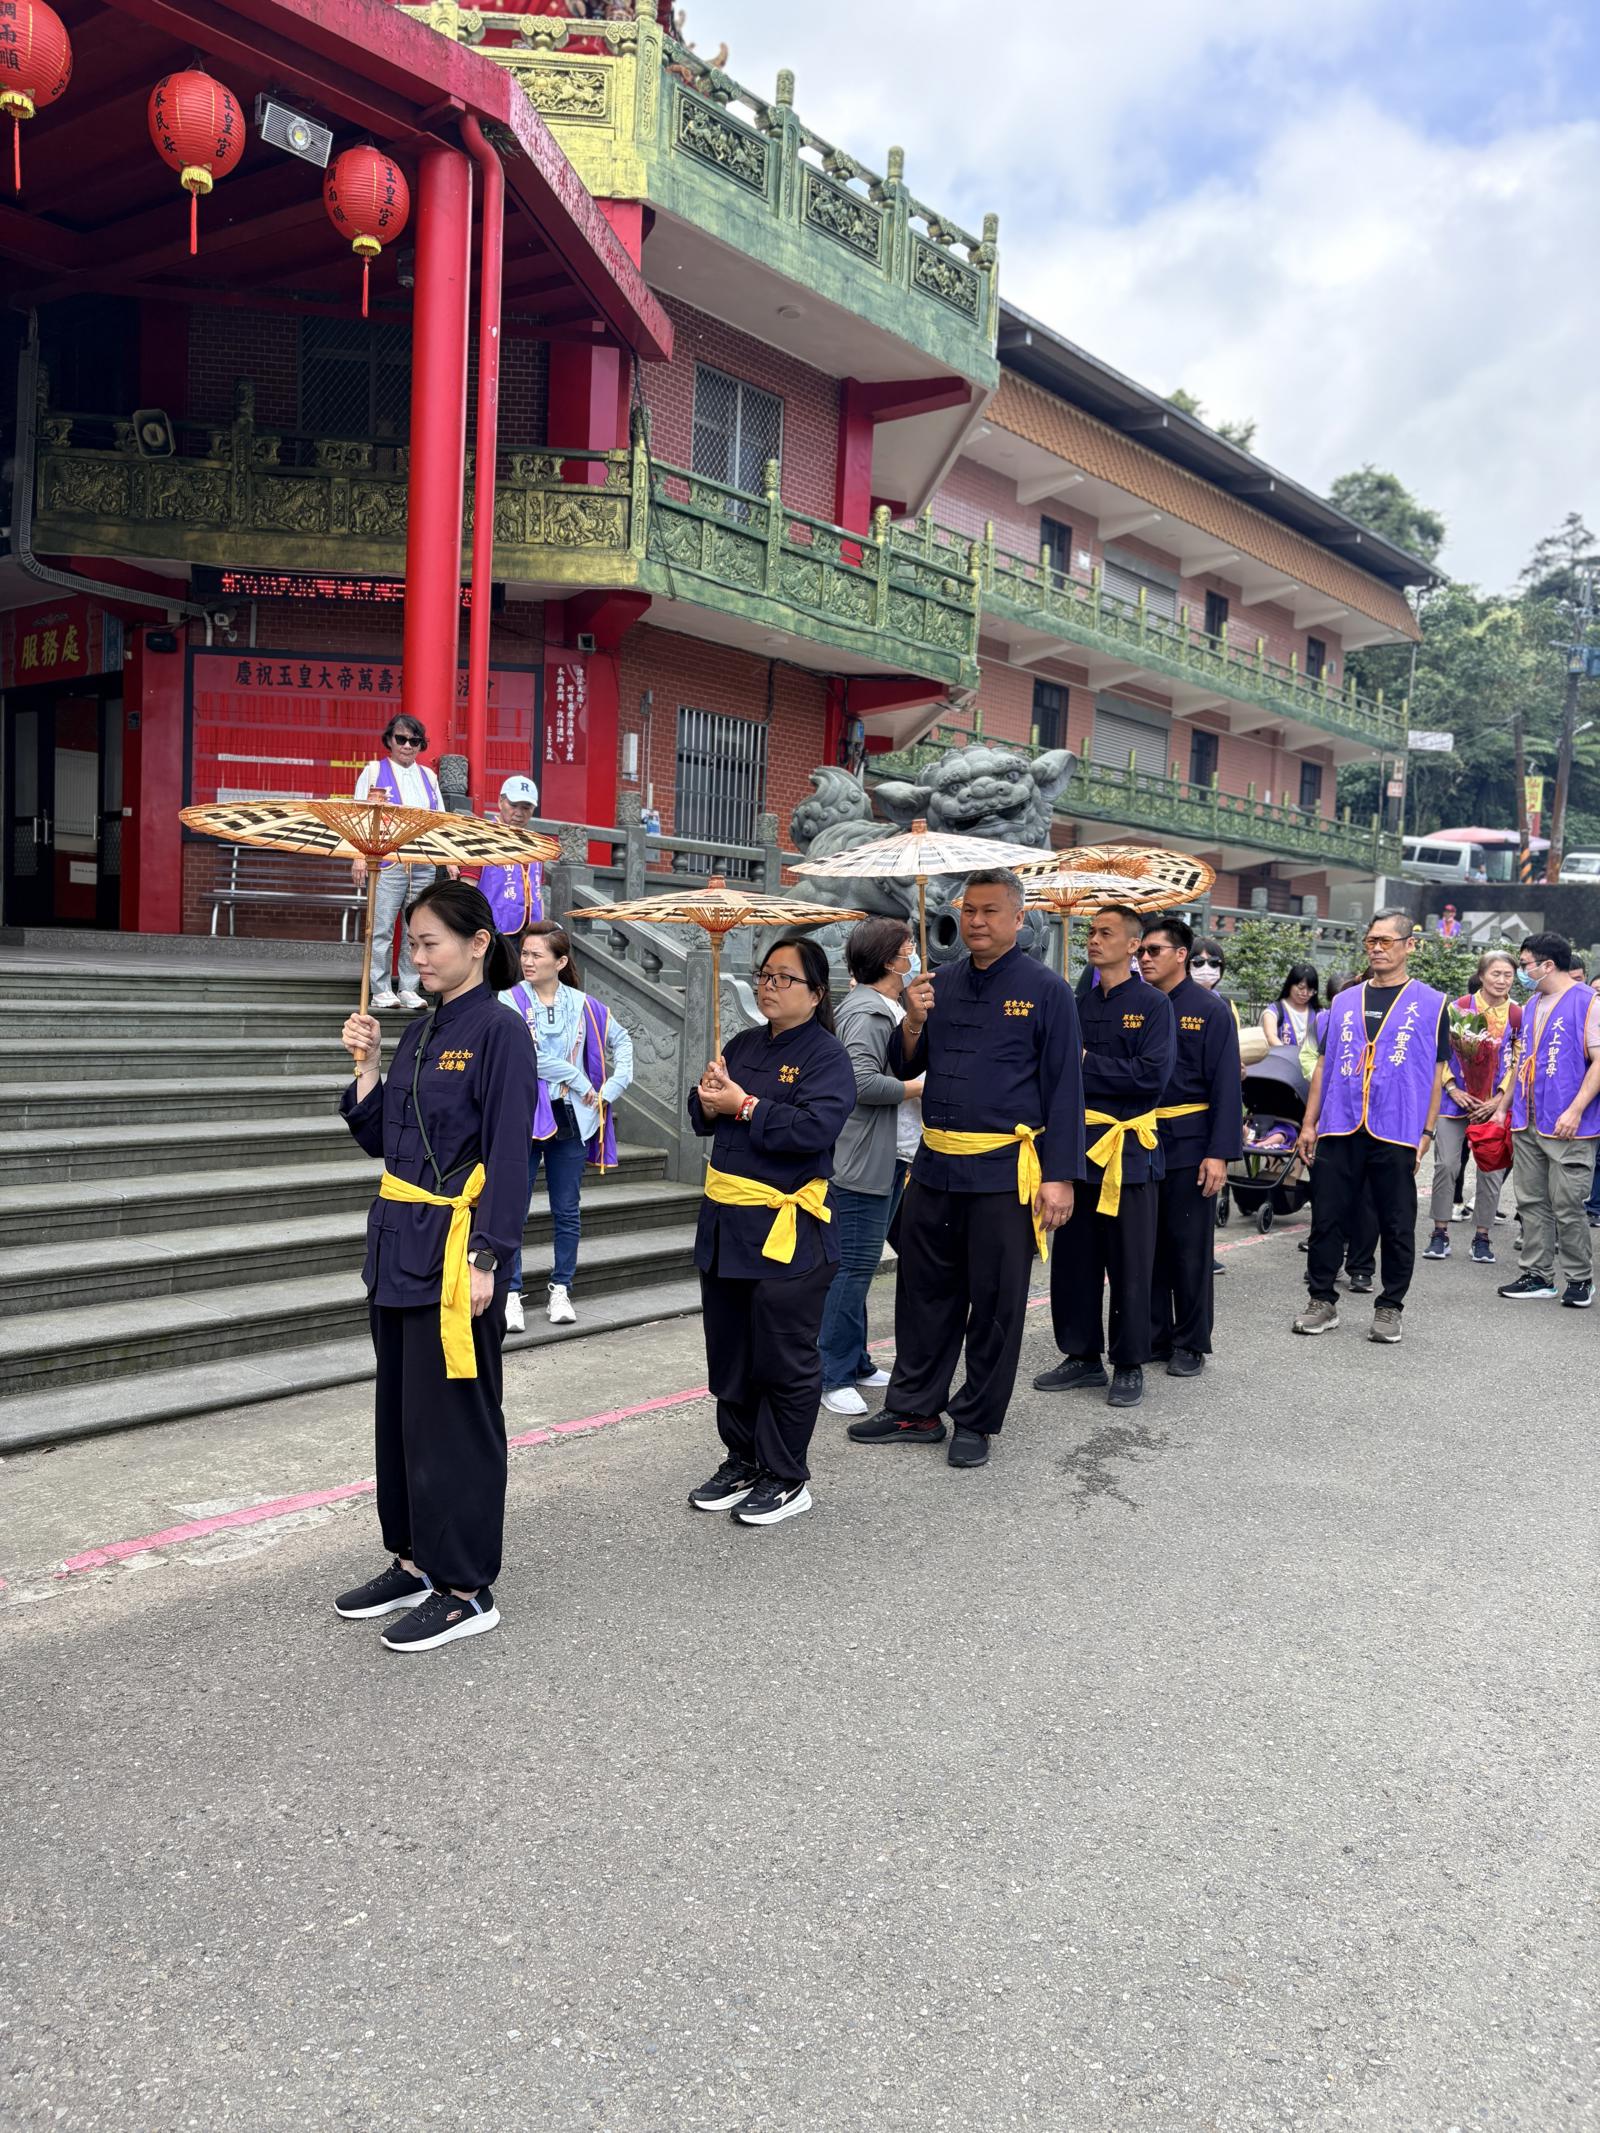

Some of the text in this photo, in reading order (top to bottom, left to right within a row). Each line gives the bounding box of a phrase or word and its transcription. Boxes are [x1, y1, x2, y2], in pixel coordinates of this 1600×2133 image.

[21, 624, 80, 670] 服務處
[521, 782, 530, 793] R
[1388, 1001, 1420, 1066] 天上聖母
[1546, 1016, 1566, 1078] 天上聖母
